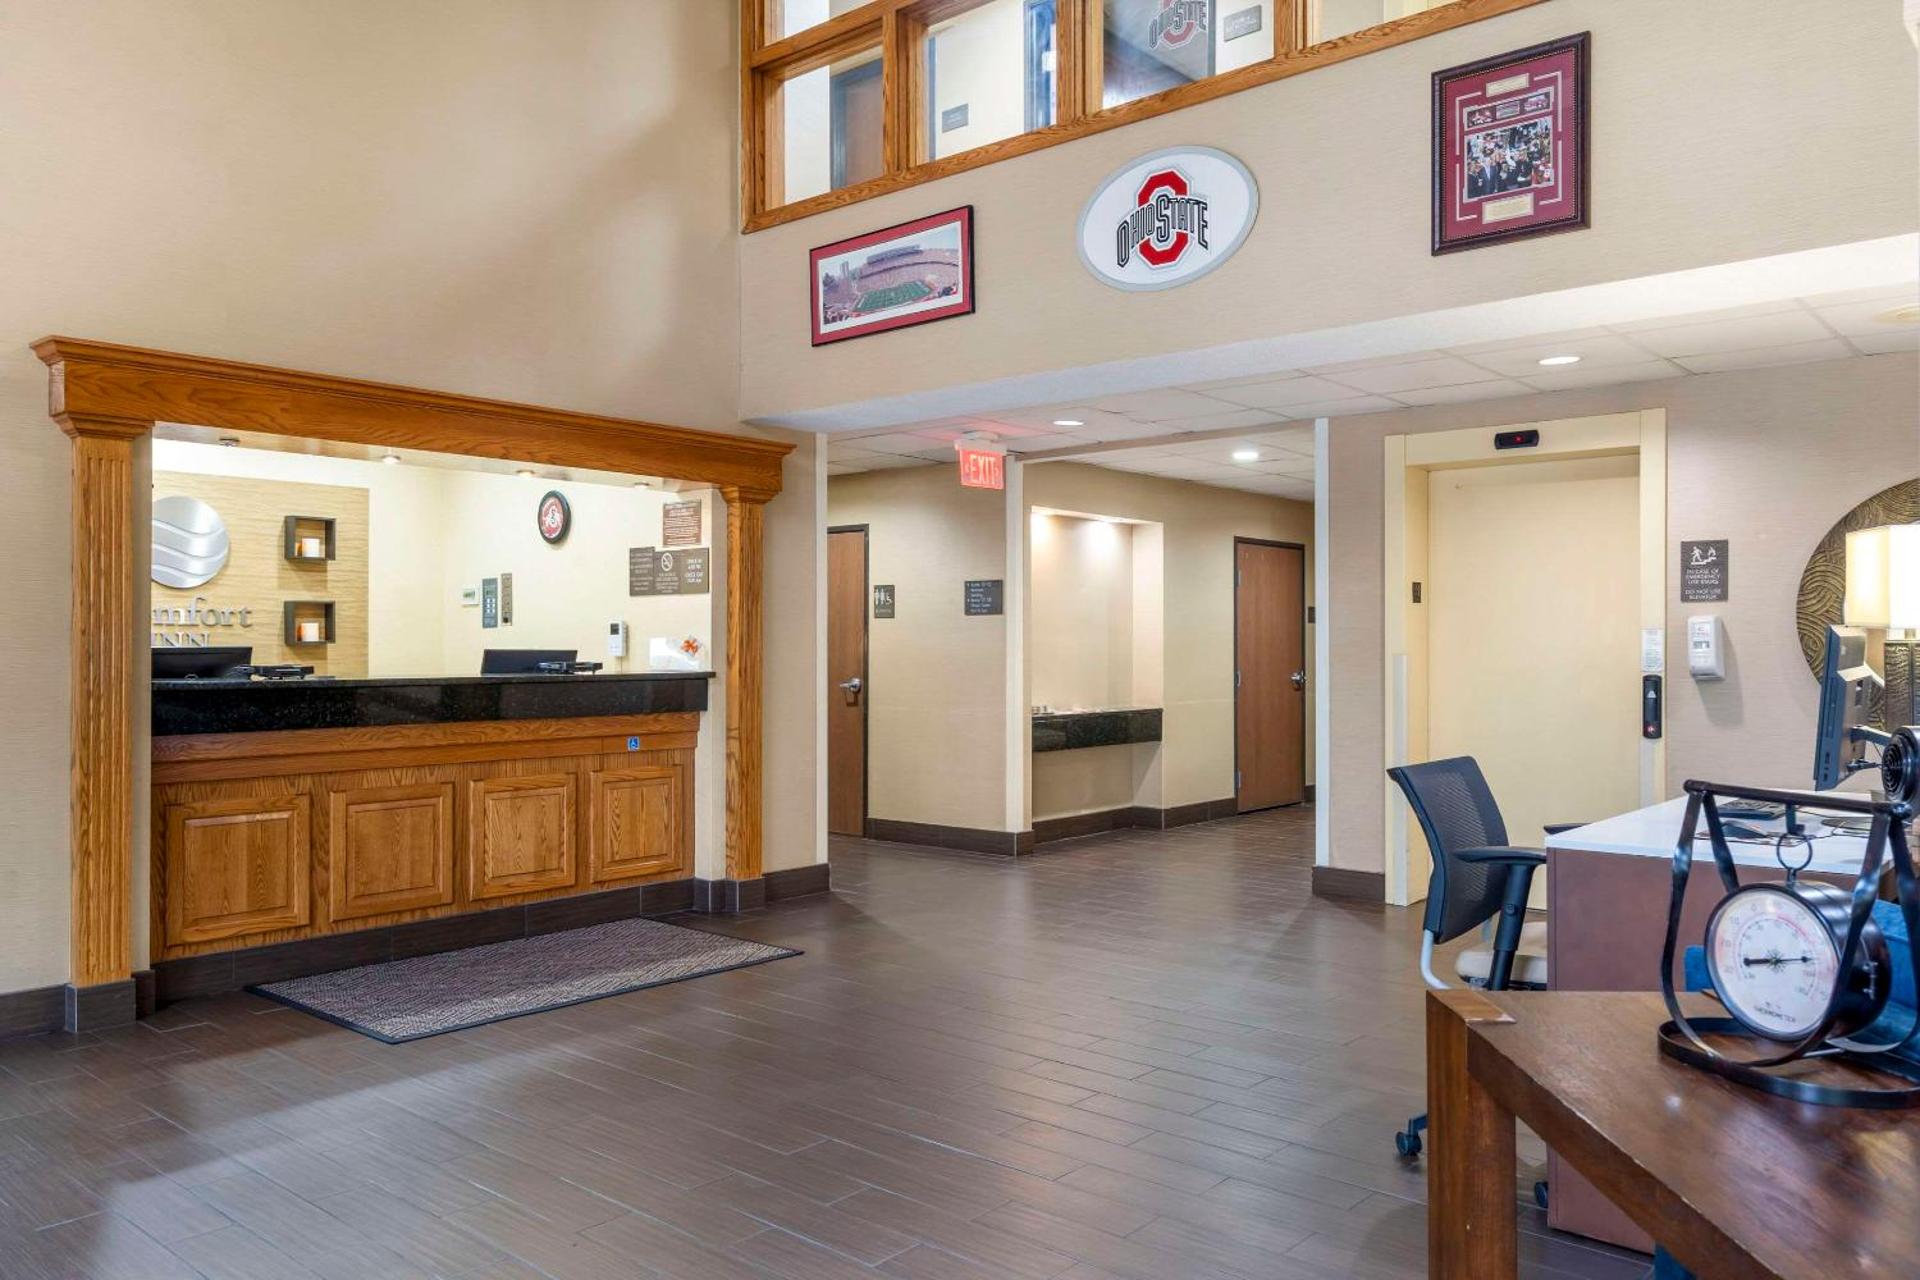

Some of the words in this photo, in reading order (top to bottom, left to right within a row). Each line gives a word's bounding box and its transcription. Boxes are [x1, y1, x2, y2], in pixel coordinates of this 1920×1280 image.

[1116, 202, 1155, 268] OHIO
[1155, 193, 1208, 251] STATE
[970, 454, 996, 485] EXIT
